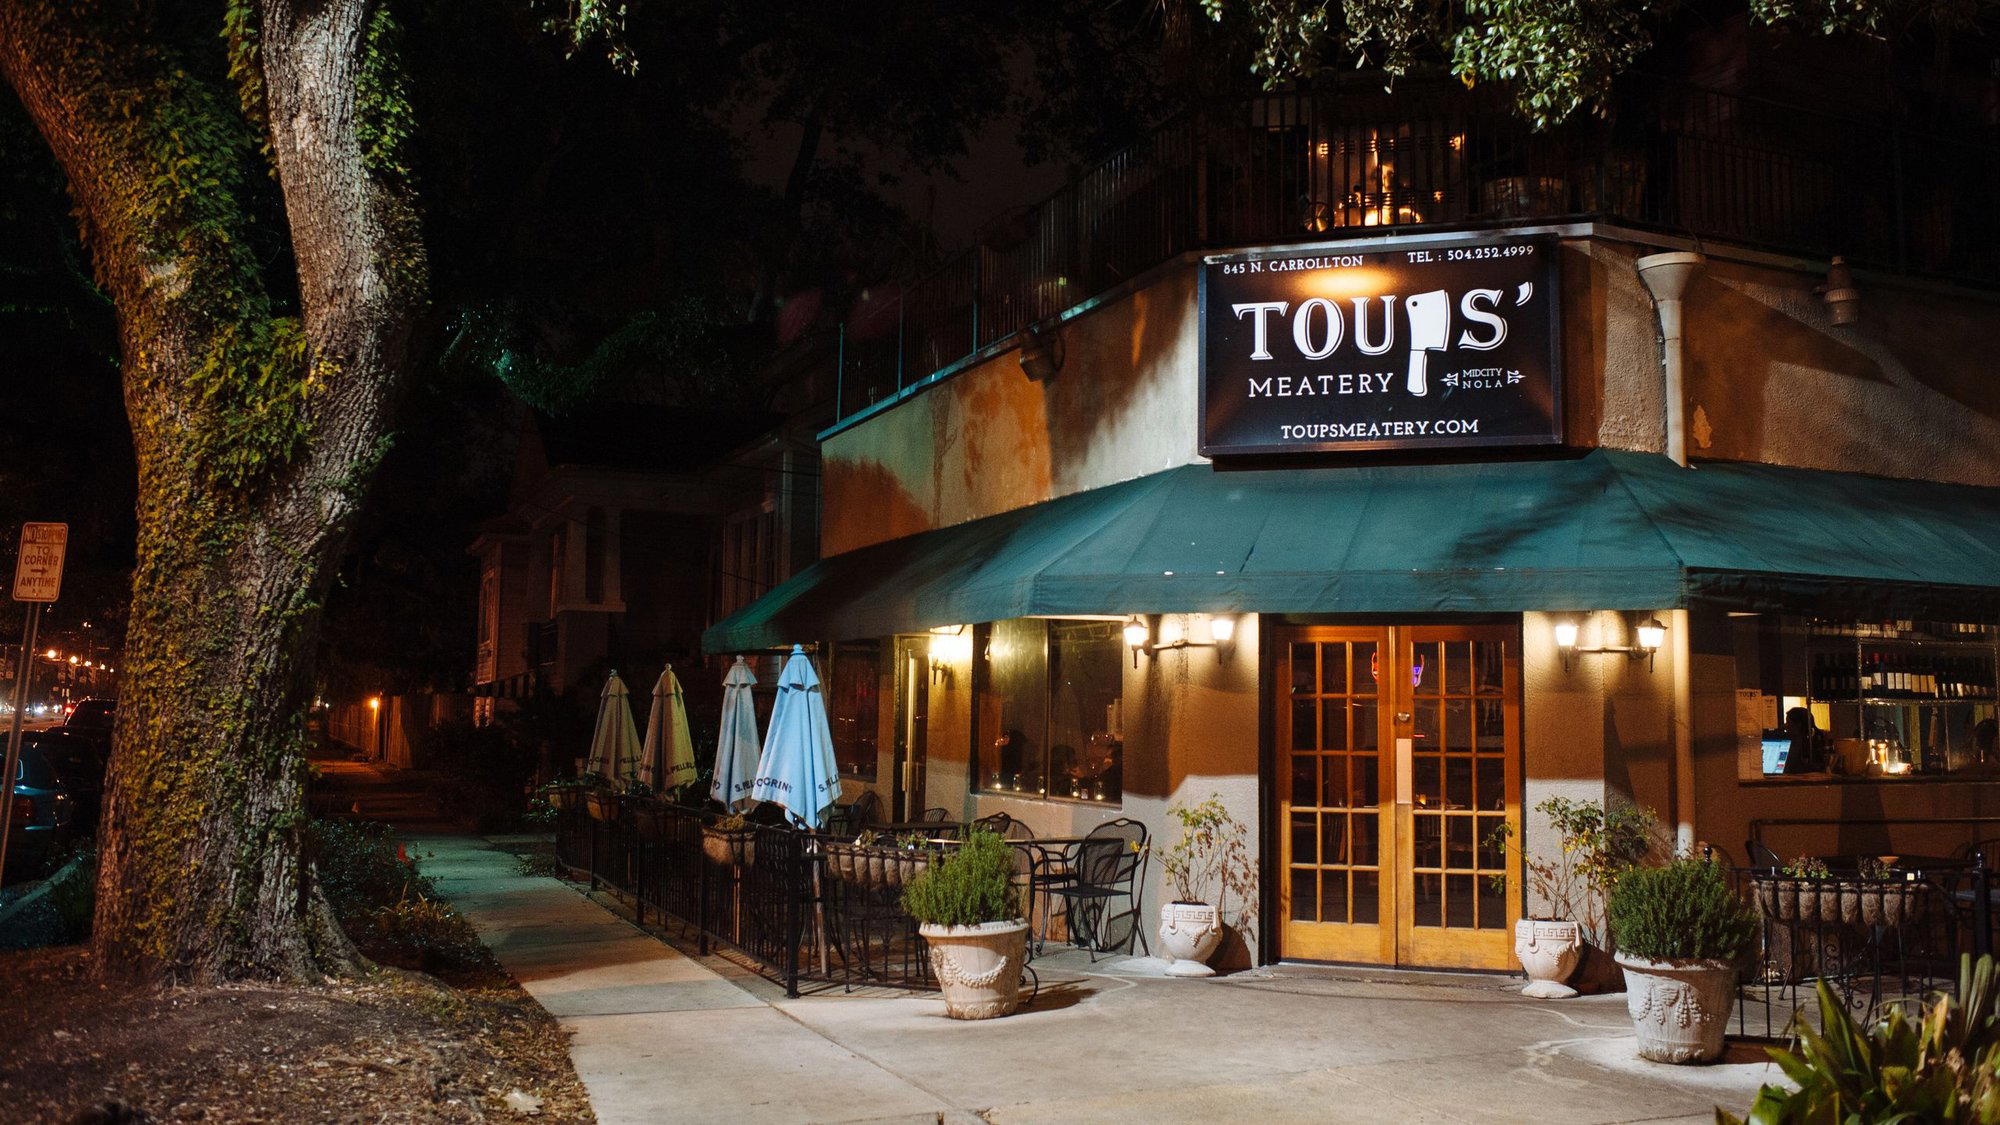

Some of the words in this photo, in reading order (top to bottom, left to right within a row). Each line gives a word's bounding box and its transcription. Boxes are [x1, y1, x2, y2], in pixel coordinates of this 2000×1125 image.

[1407, 251, 1434, 263] TEL
[1447, 245, 1534, 261] 504.252.4999
[1223, 264, 1246, 275] 845
[1250, 262, 1265, 273] N.
[1269, 255, 1364, 273] CARROLLTON
[1462, 367, 1503, 378] MIDCITY
[1248, 372, 1394, 398] MEATERY
[1462, 380, 1503, 389] NOLA
[1281, 419, 1479, 440] TOUPSMEATERY.COM
[36, 545, 50, 555] TO
[24, 554, 59, 566] CORNER
[20, 577, 56, 587] ANYTIME
